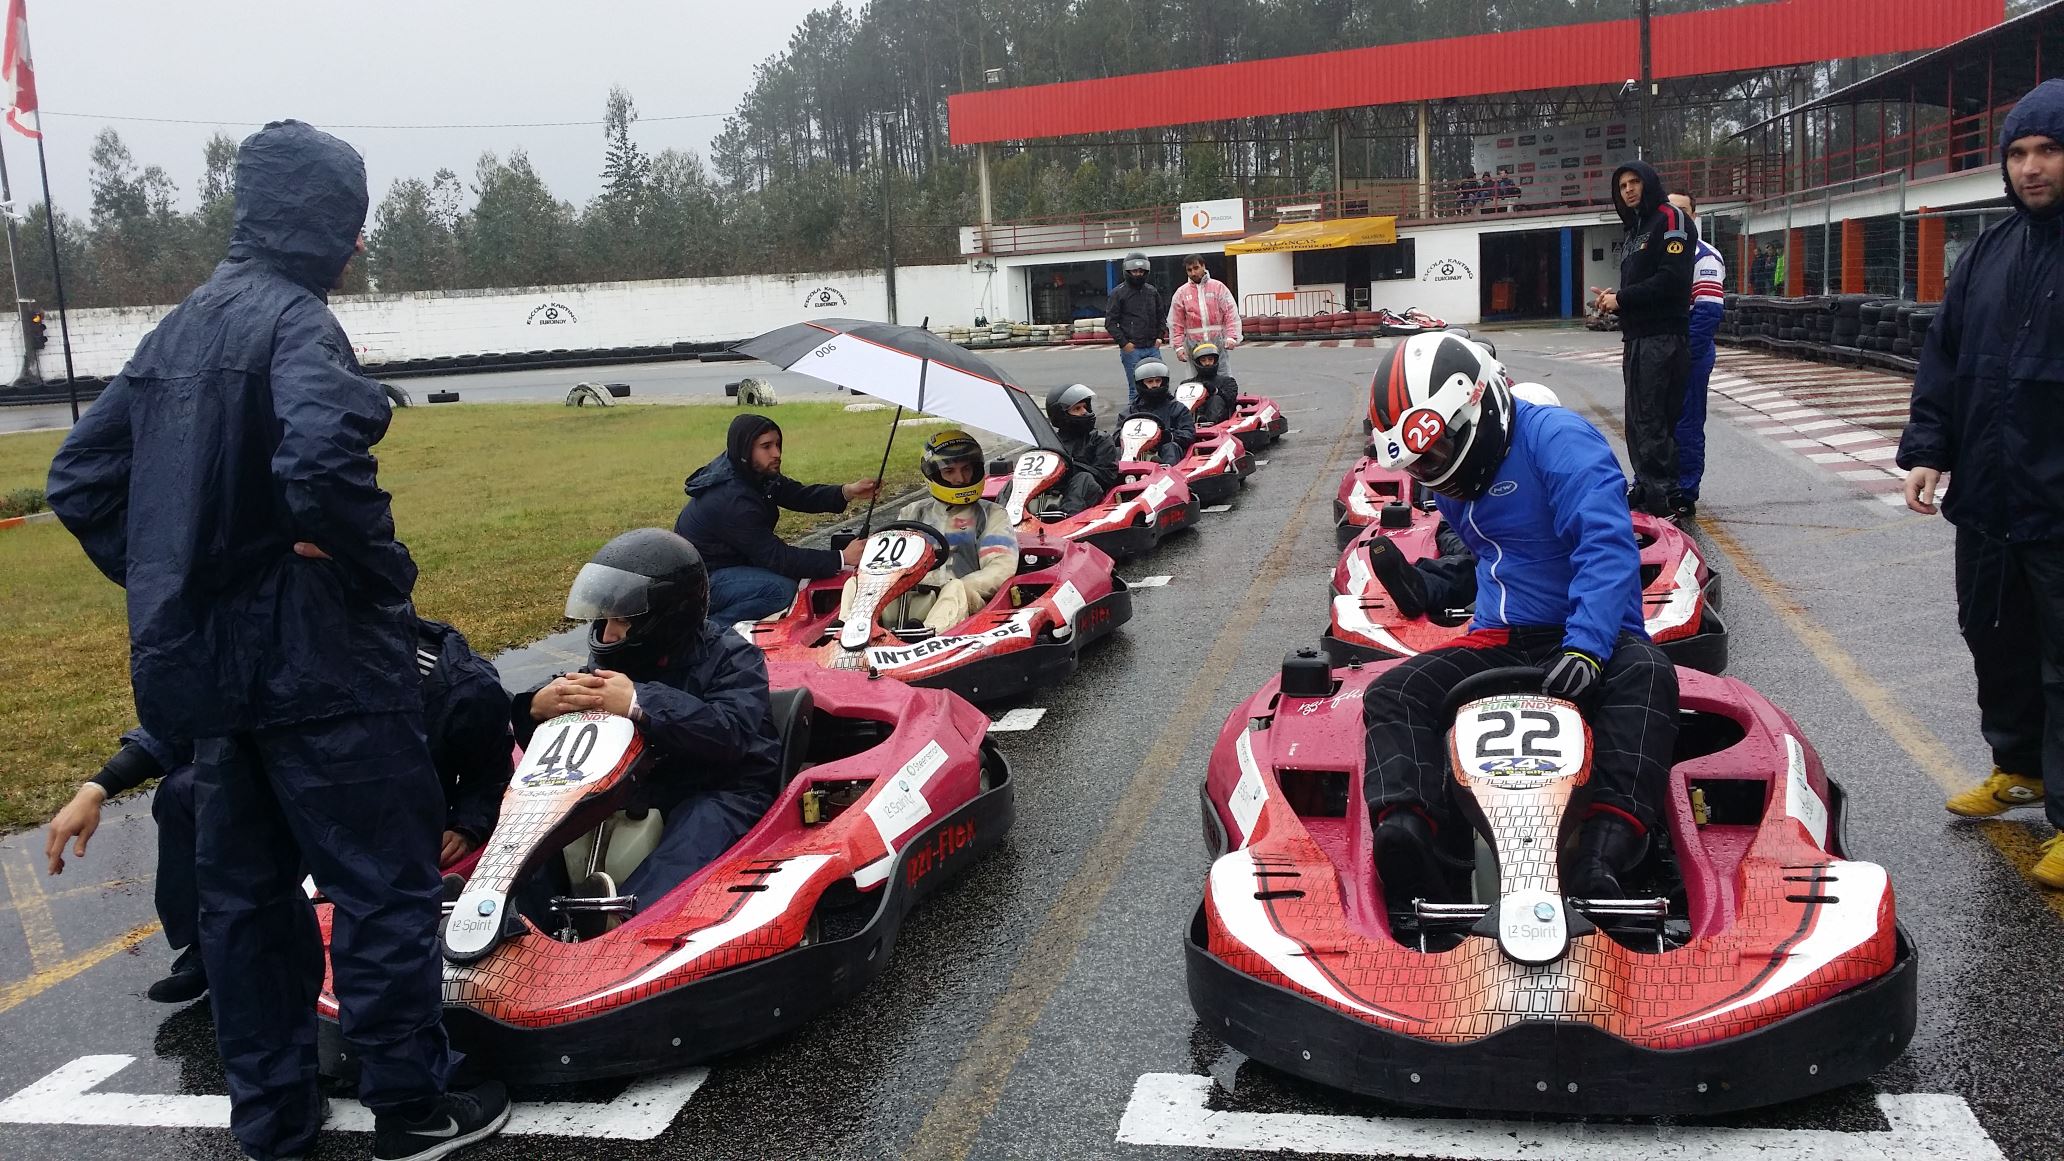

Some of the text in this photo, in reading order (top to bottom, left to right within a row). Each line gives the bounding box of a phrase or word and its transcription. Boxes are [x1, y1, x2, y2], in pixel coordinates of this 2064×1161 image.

[1422, 258, 1474, 281] ESCOLA KARTING
[804, 286, 847, 308] ESCOLA KARTING
[527, 302, 577, 325] ESCOLA KARTING
[1190, 386, 1195, 396] 7
[1469, 380, 1486, 407] 3M
[1134, 421, 1142, 434] 4
[1408, 412, 1441, 449] 25
[1020, 455, 1045, 472] 32
[872, 536, 907, 562] 20
[875, 623, 1024, 665] INTERMDE
[1476, 710, 1562, 758] 22
[536, 722, 599, 773] 40
[462, 919, 492, 933] Spirit
[1521, 924, 1557, 941] Spirit
